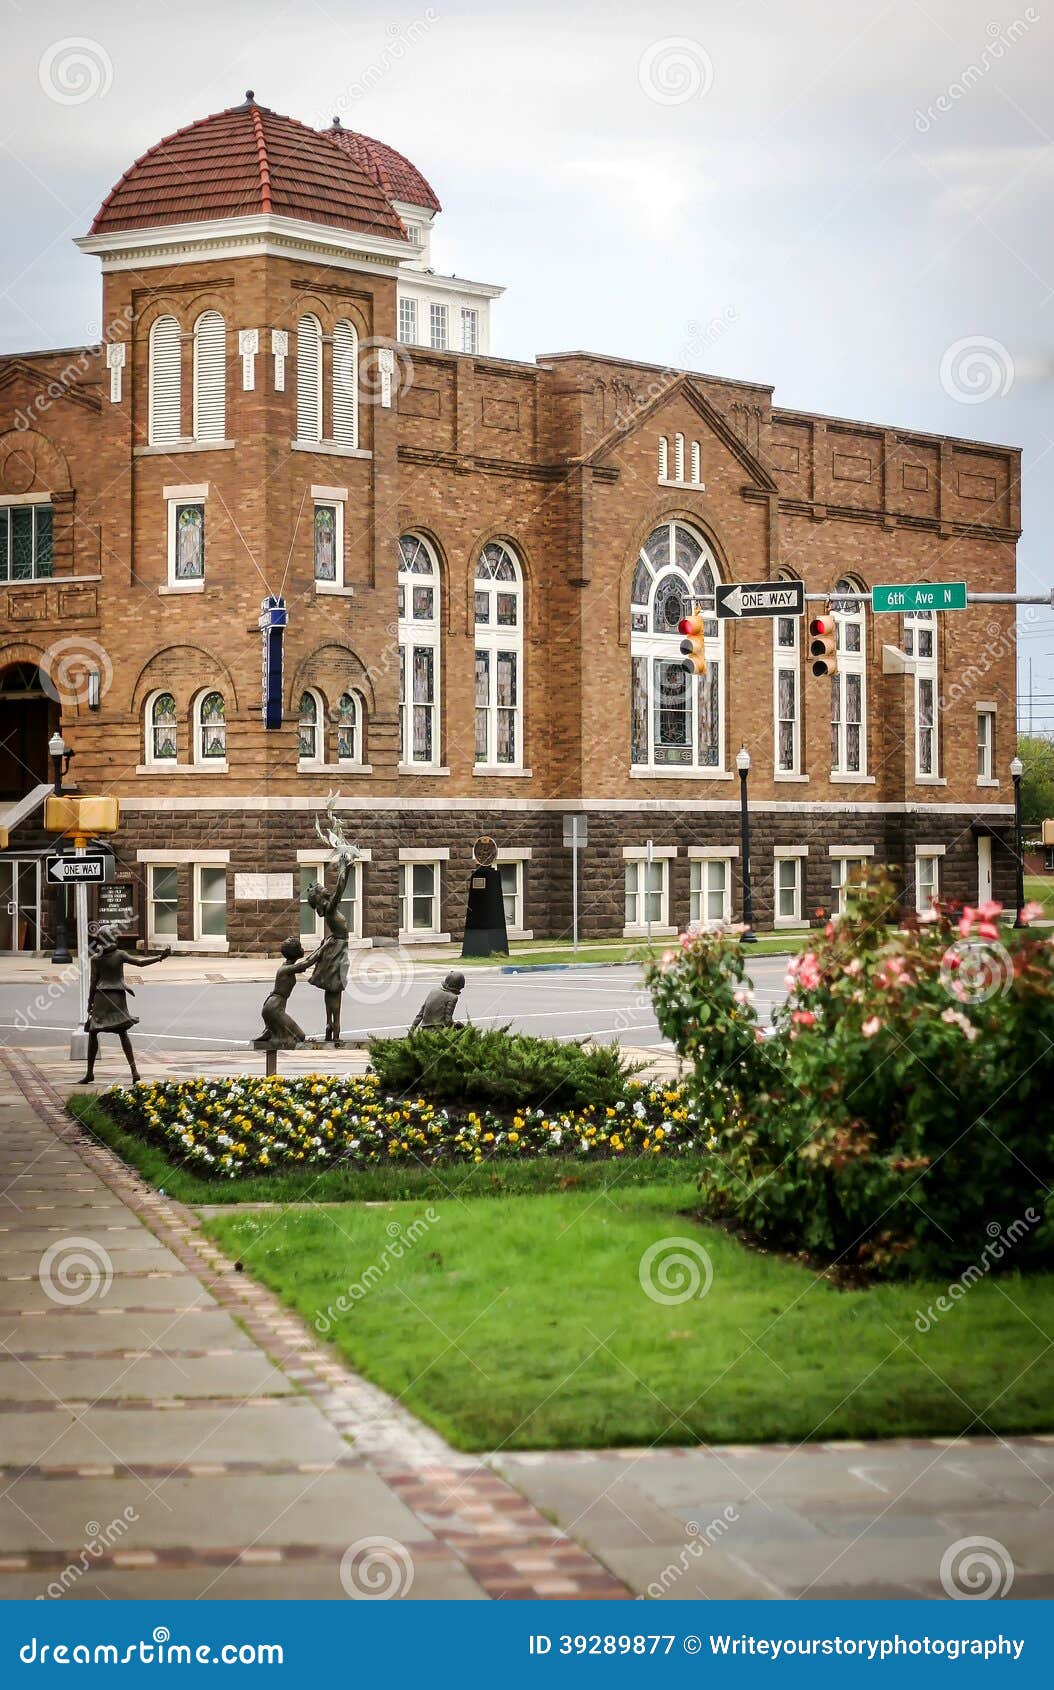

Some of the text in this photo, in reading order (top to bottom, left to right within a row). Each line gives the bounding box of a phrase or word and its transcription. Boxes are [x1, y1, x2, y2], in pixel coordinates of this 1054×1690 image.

[742, 591, 793, 607] ONE WAY
[887, 589, 952, 605] 6th Ave N
[64, 864, 98, 875] ONE WAY
